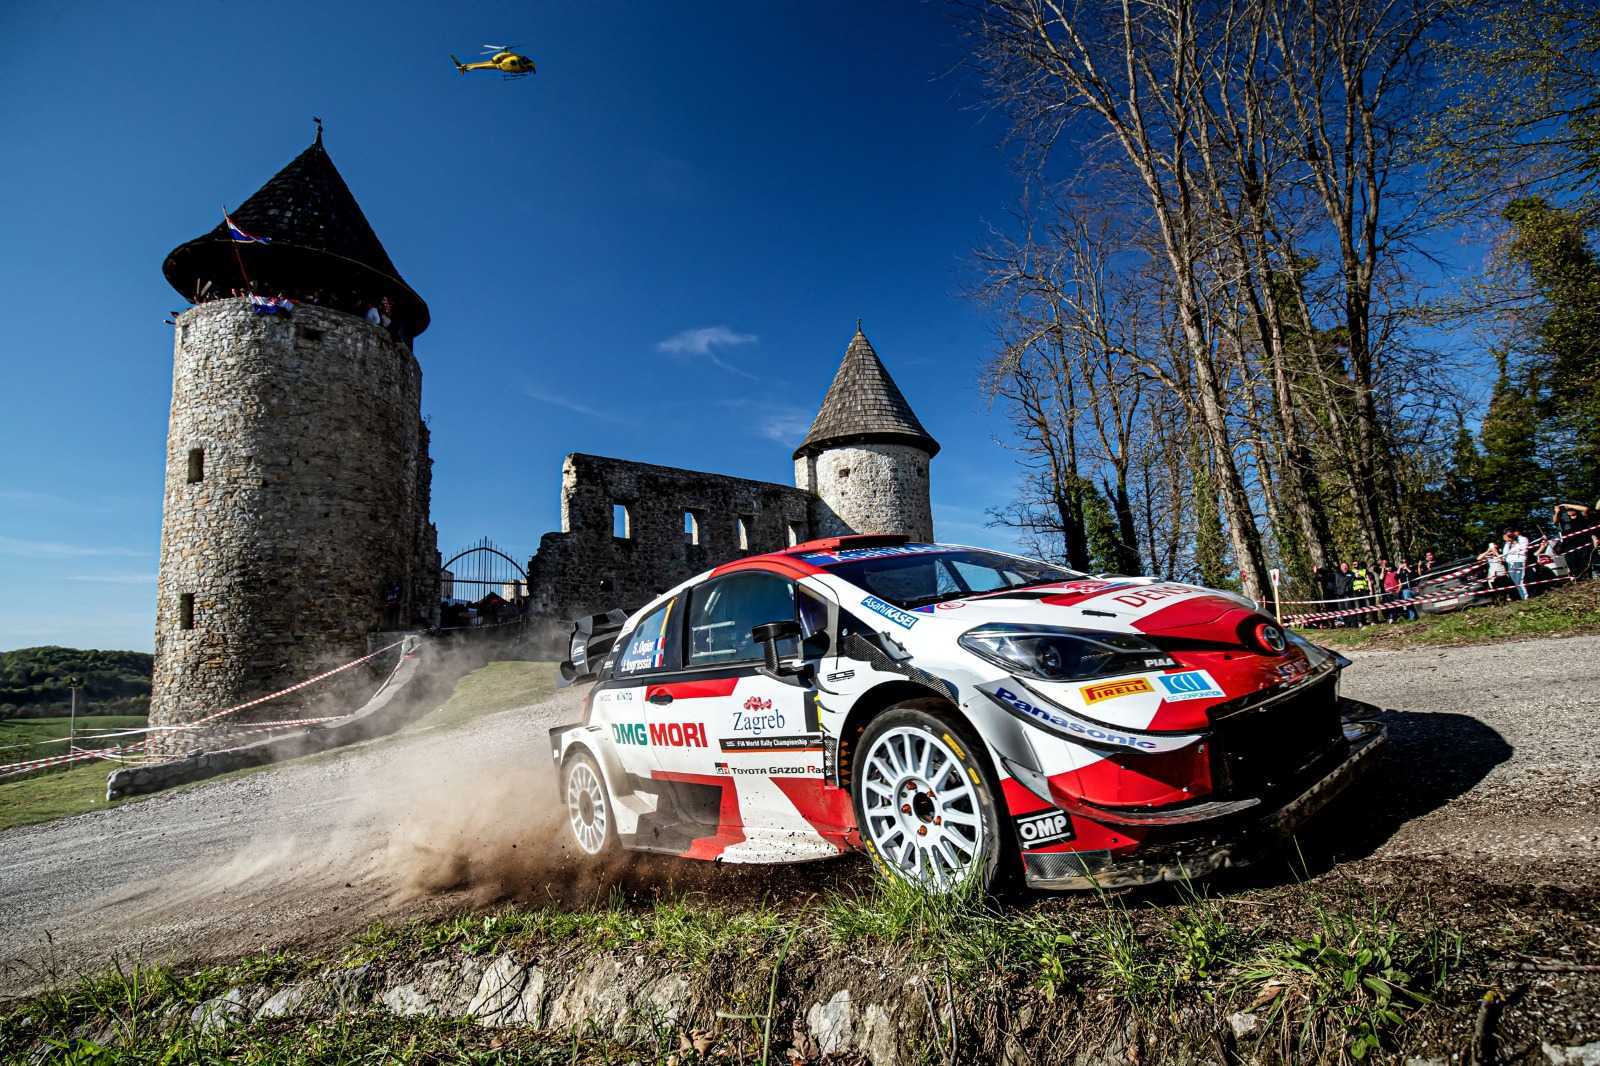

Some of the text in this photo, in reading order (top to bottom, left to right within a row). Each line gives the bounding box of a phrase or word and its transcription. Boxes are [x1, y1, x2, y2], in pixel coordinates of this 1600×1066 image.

[1144, 657, 1176, 668] PIAA
[1085, 679, 1148, 701] PIRELLI
[733, 709, 786, 736] Zagreb
[994, 687, 1157, 749] Panasonic
[611, 722, 709, 748] DMG MORI
[760, 740, 773, 748] Rally
[774, 738, 808, 748] Championship
[731, 767, 767, 775] TOYOTA
[769, 766, 805, 774] GAZOO
[1020, 815, 1068, 840] OMP
